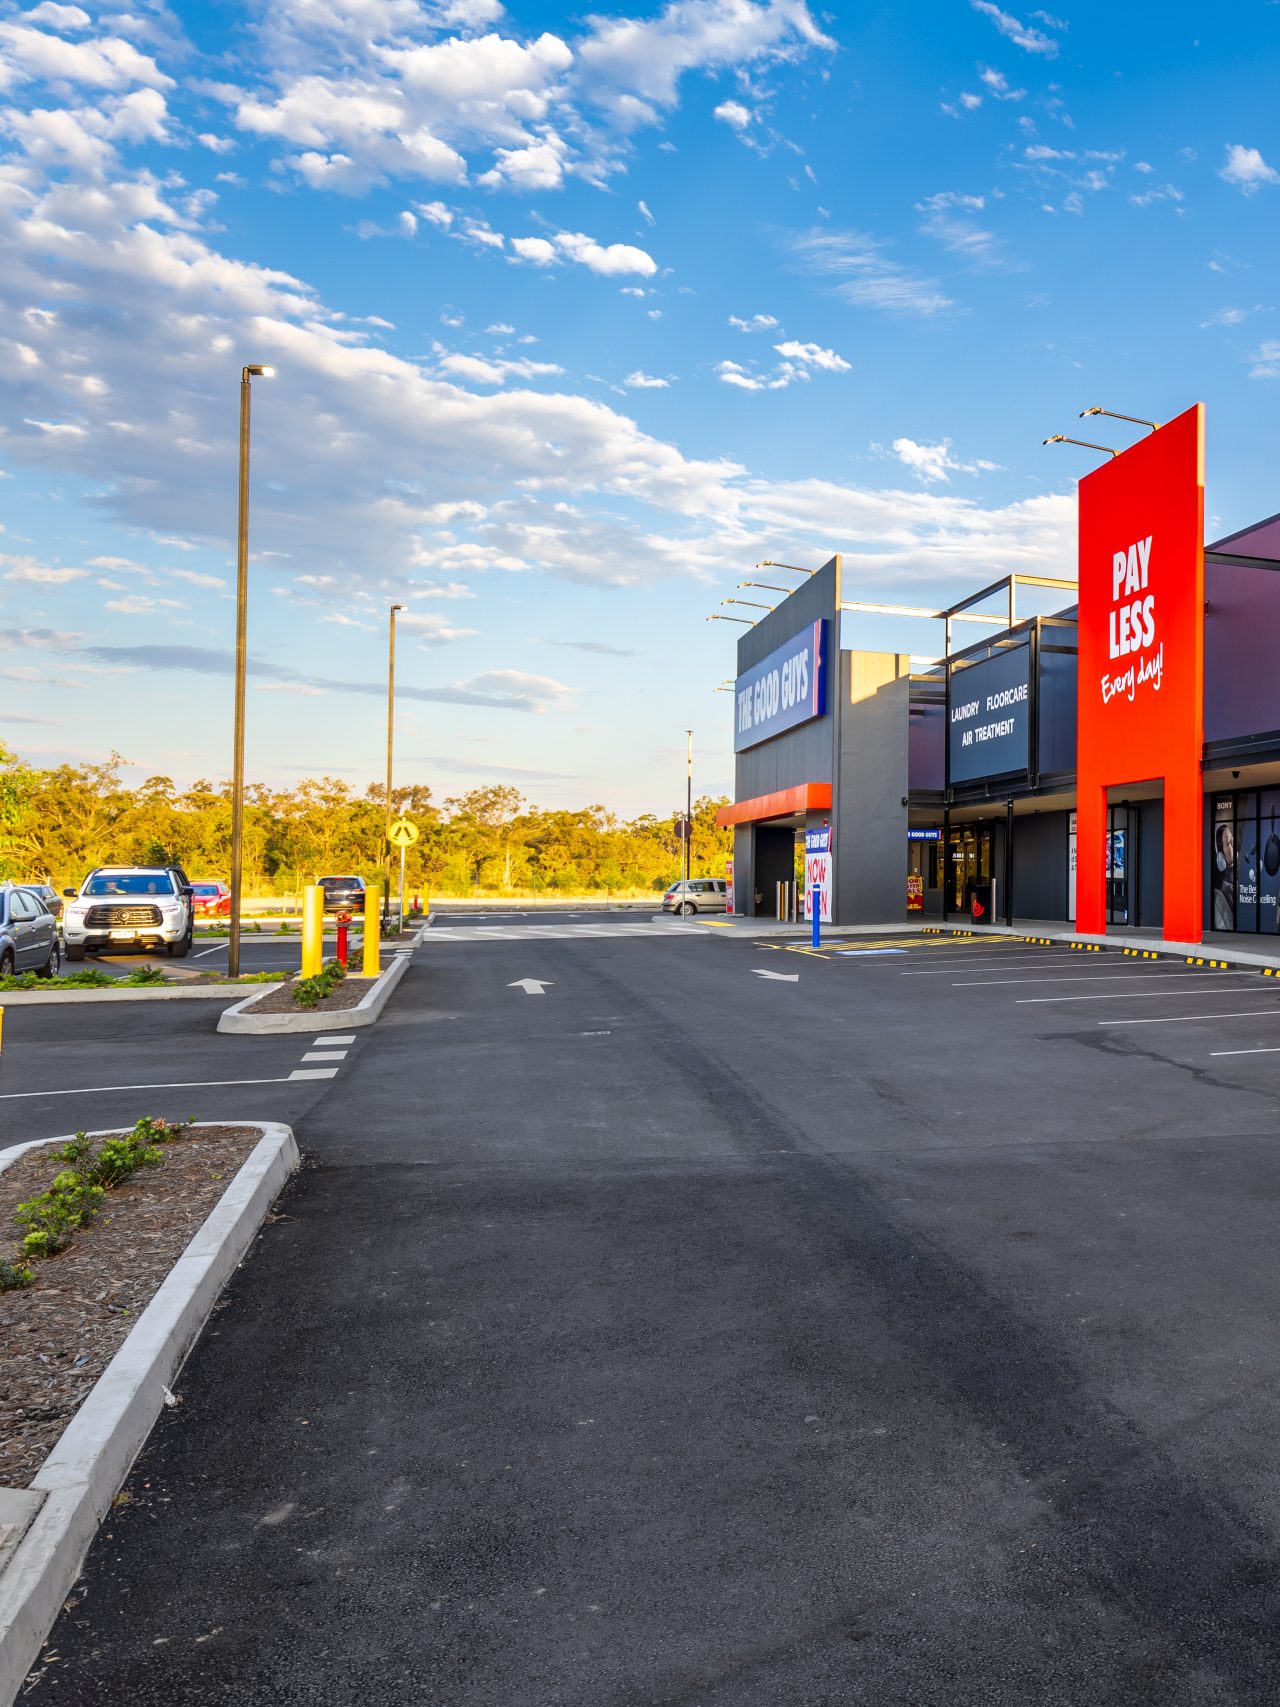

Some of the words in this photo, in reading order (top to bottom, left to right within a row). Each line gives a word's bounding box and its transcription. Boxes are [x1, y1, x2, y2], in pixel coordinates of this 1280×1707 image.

[1112, 535, 1153, 601] PAY
[1109, 594, 1155, 660] LESS
[1101, 665, 1135, 704] Every
[1137, 642, 1163, 690] day!
[738, 685, 753, 733] THE
[754, 669, 780, 726] GOOD
[781, 647, 809, 711] GUYS
[951, 700, 980, 723] LAUNDRY
[986, 684, 1028, 711] FLOORCARE
[962, 730, 973, 747] AIR
[974, 718, 1015, 743] TREATMENT
[1216, 801, 1233, 809] SONY
[806, 858, 827, 884] NOW
[806, 889, 828, 916] ON
[1239, 884, 1249, 894] The
[1248, 884, 1257, 894] Bes
[1239, 894, 1253, 904] Noise
